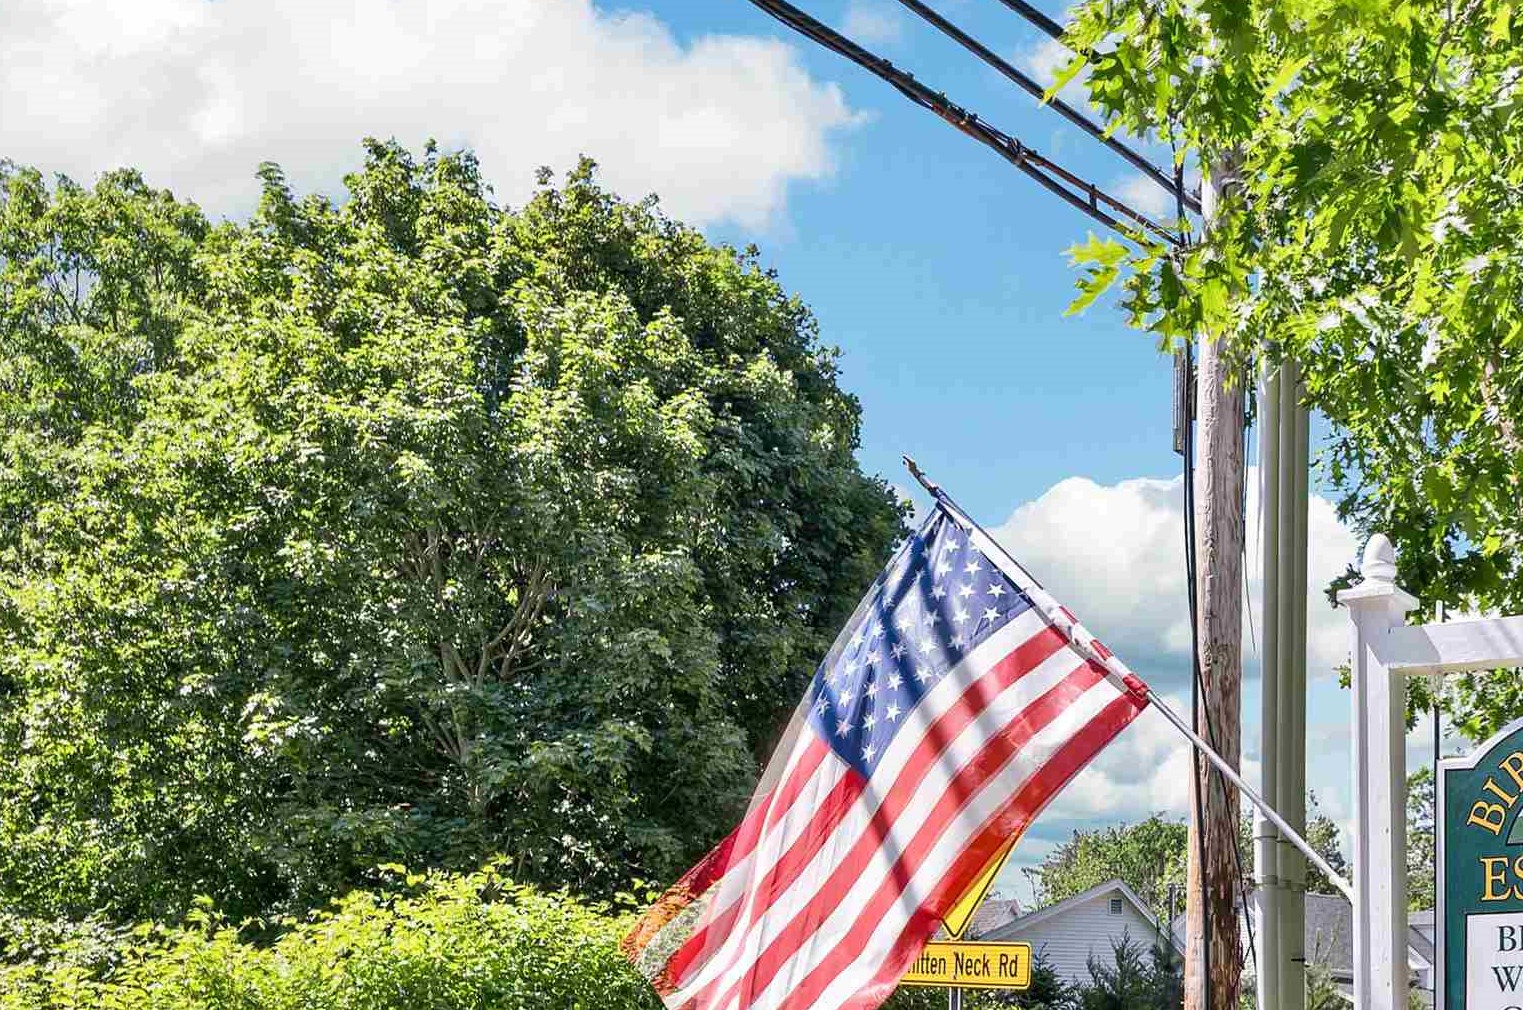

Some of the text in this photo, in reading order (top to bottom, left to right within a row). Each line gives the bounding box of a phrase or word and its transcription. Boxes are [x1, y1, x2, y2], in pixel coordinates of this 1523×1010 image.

[907, 951, 1018, 977] itten Neck Rd
